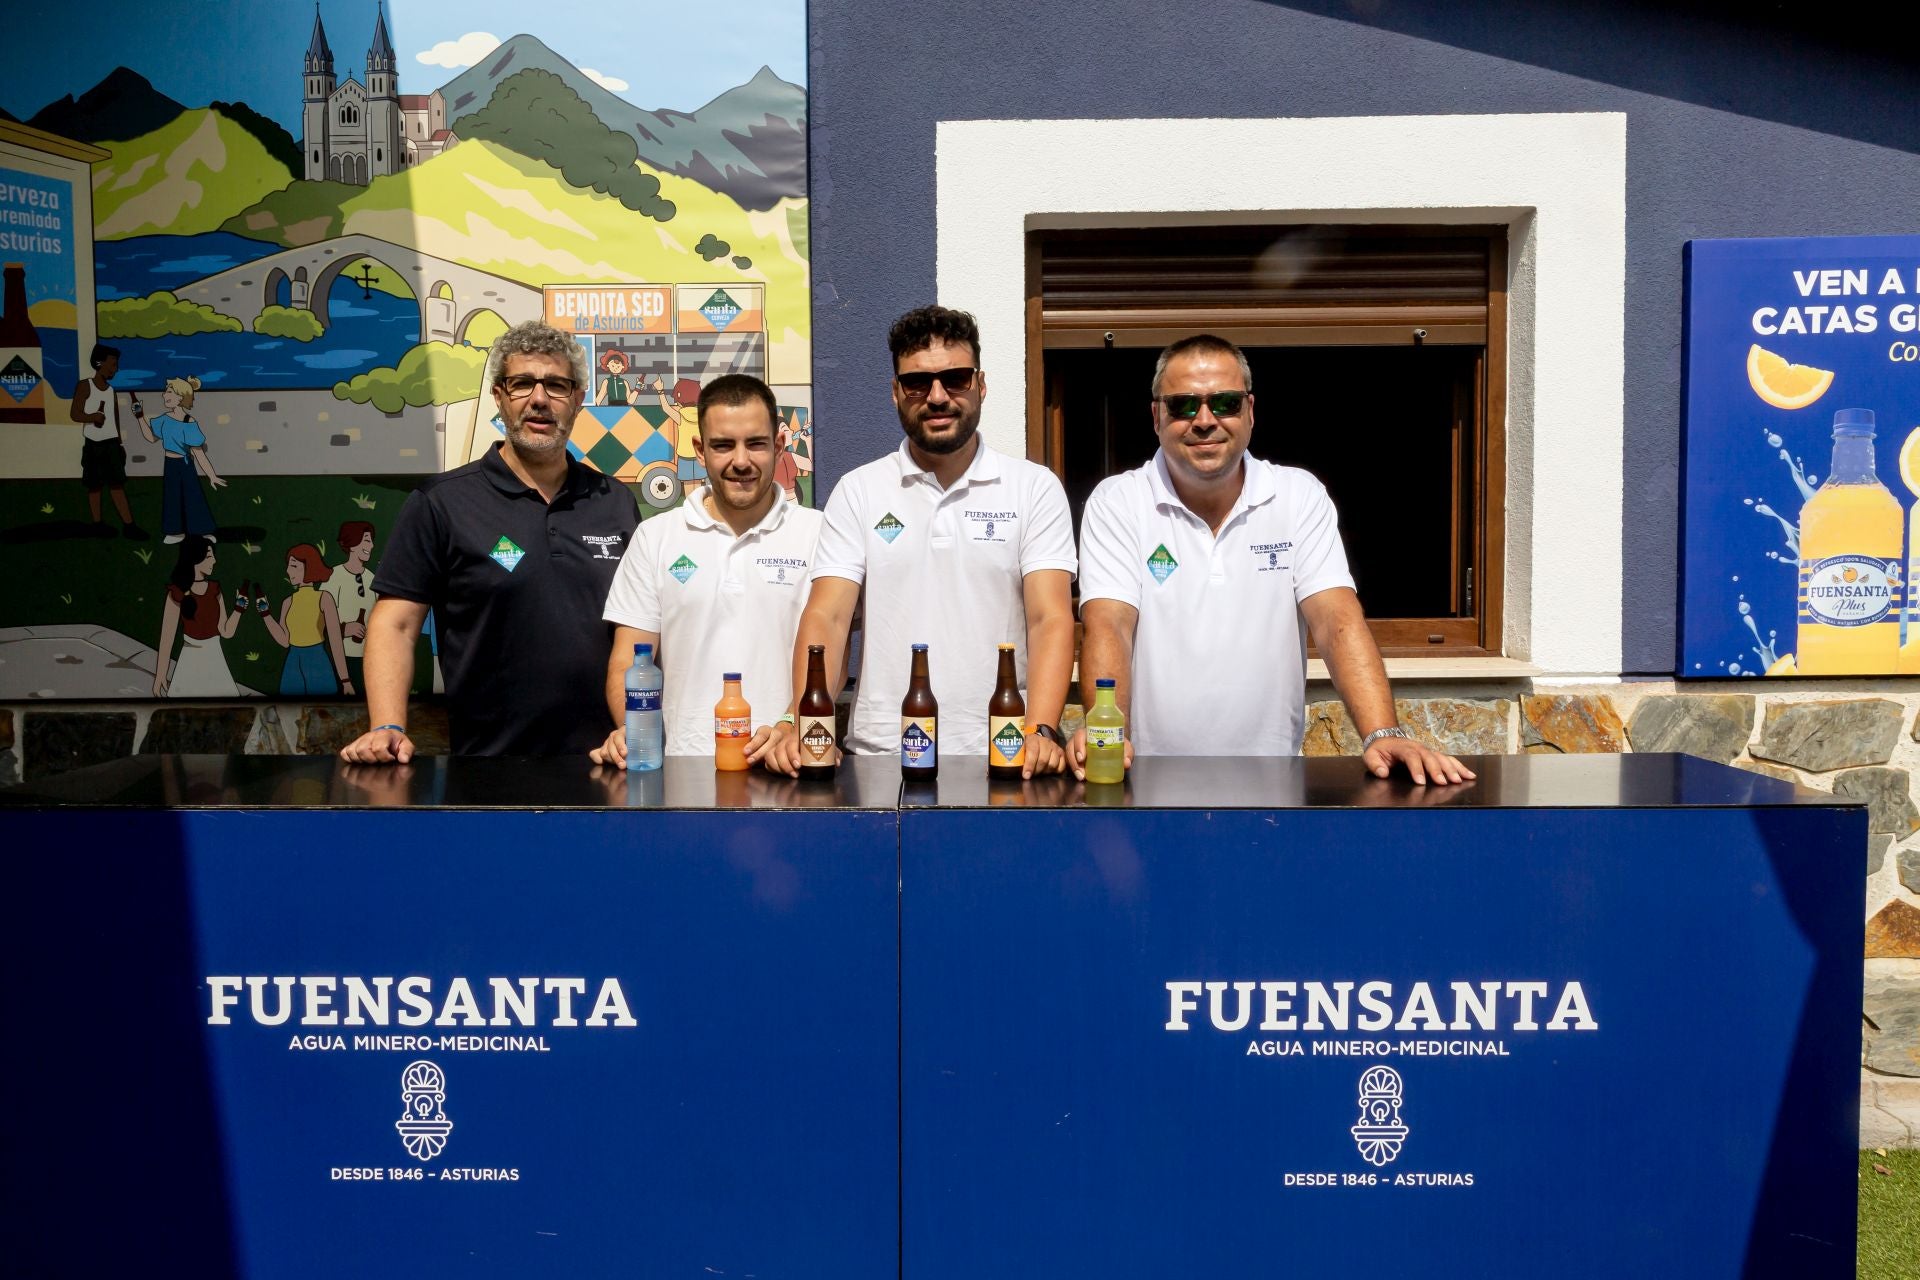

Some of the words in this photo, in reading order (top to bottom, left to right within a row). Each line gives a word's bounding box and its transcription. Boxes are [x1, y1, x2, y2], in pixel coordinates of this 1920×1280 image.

[0, 183, 59, 210] erveza
[0, 210, 61, 230] remiada
[0, 231, 62, 254] sturias
[1793, 269, 1868, 296] VEN
[1878, 268, 1905, 294] A
[554, 292, 628, 317] BENDITA
[631, 292, 665, 317] SED
[704, 303, 737, 314] santa
[575, 314, 589, 331] de
[593, 313, 645, 331] Asturias
[1752, 305, 1878, 335] CATAS
[1889, 304, 1920, 333] G
[1889, 341, 1920, 362] Co
[1, 372, 36, 384] santa
[964, 510, 1018, 519] FUENSANTA
[1249, 541, 1293, 551] FUENSANTA
[756, 558, 808, 568] FUENSANTA
[1810, 586, 1889, 598] FUENSANTA
[1832, 599, 1867, 616] Plus
[803, 735, 832, 746] santa
[902, 736, 930, 747] santa
[995, 735, 1023, 746] santa
[206, 976, 638, 1027] FUENSANTA
[1165, 981, 1598, 1031] FUENSANTA
[289, 1035, 347, 1051] AGUA
[355, 1035, 551, 1052] MINERO-MEDICINAL
[1246, 1040, 1304, 1056] AGUA
[1312, 1040, 1510, 1056] MINERO-MEDICINAL
[331, 1168, 383, 1180] DESDE
[388, 1168, 424, 1181] 1846
[440, 1168, 520, 1181] ASTURIAS
[1284, 1173, 1337, 1186] DESDE
[1342, 1173, 1378, 1186] 1846
[1394, 1173, 1474, 1186] ASTURIAS
